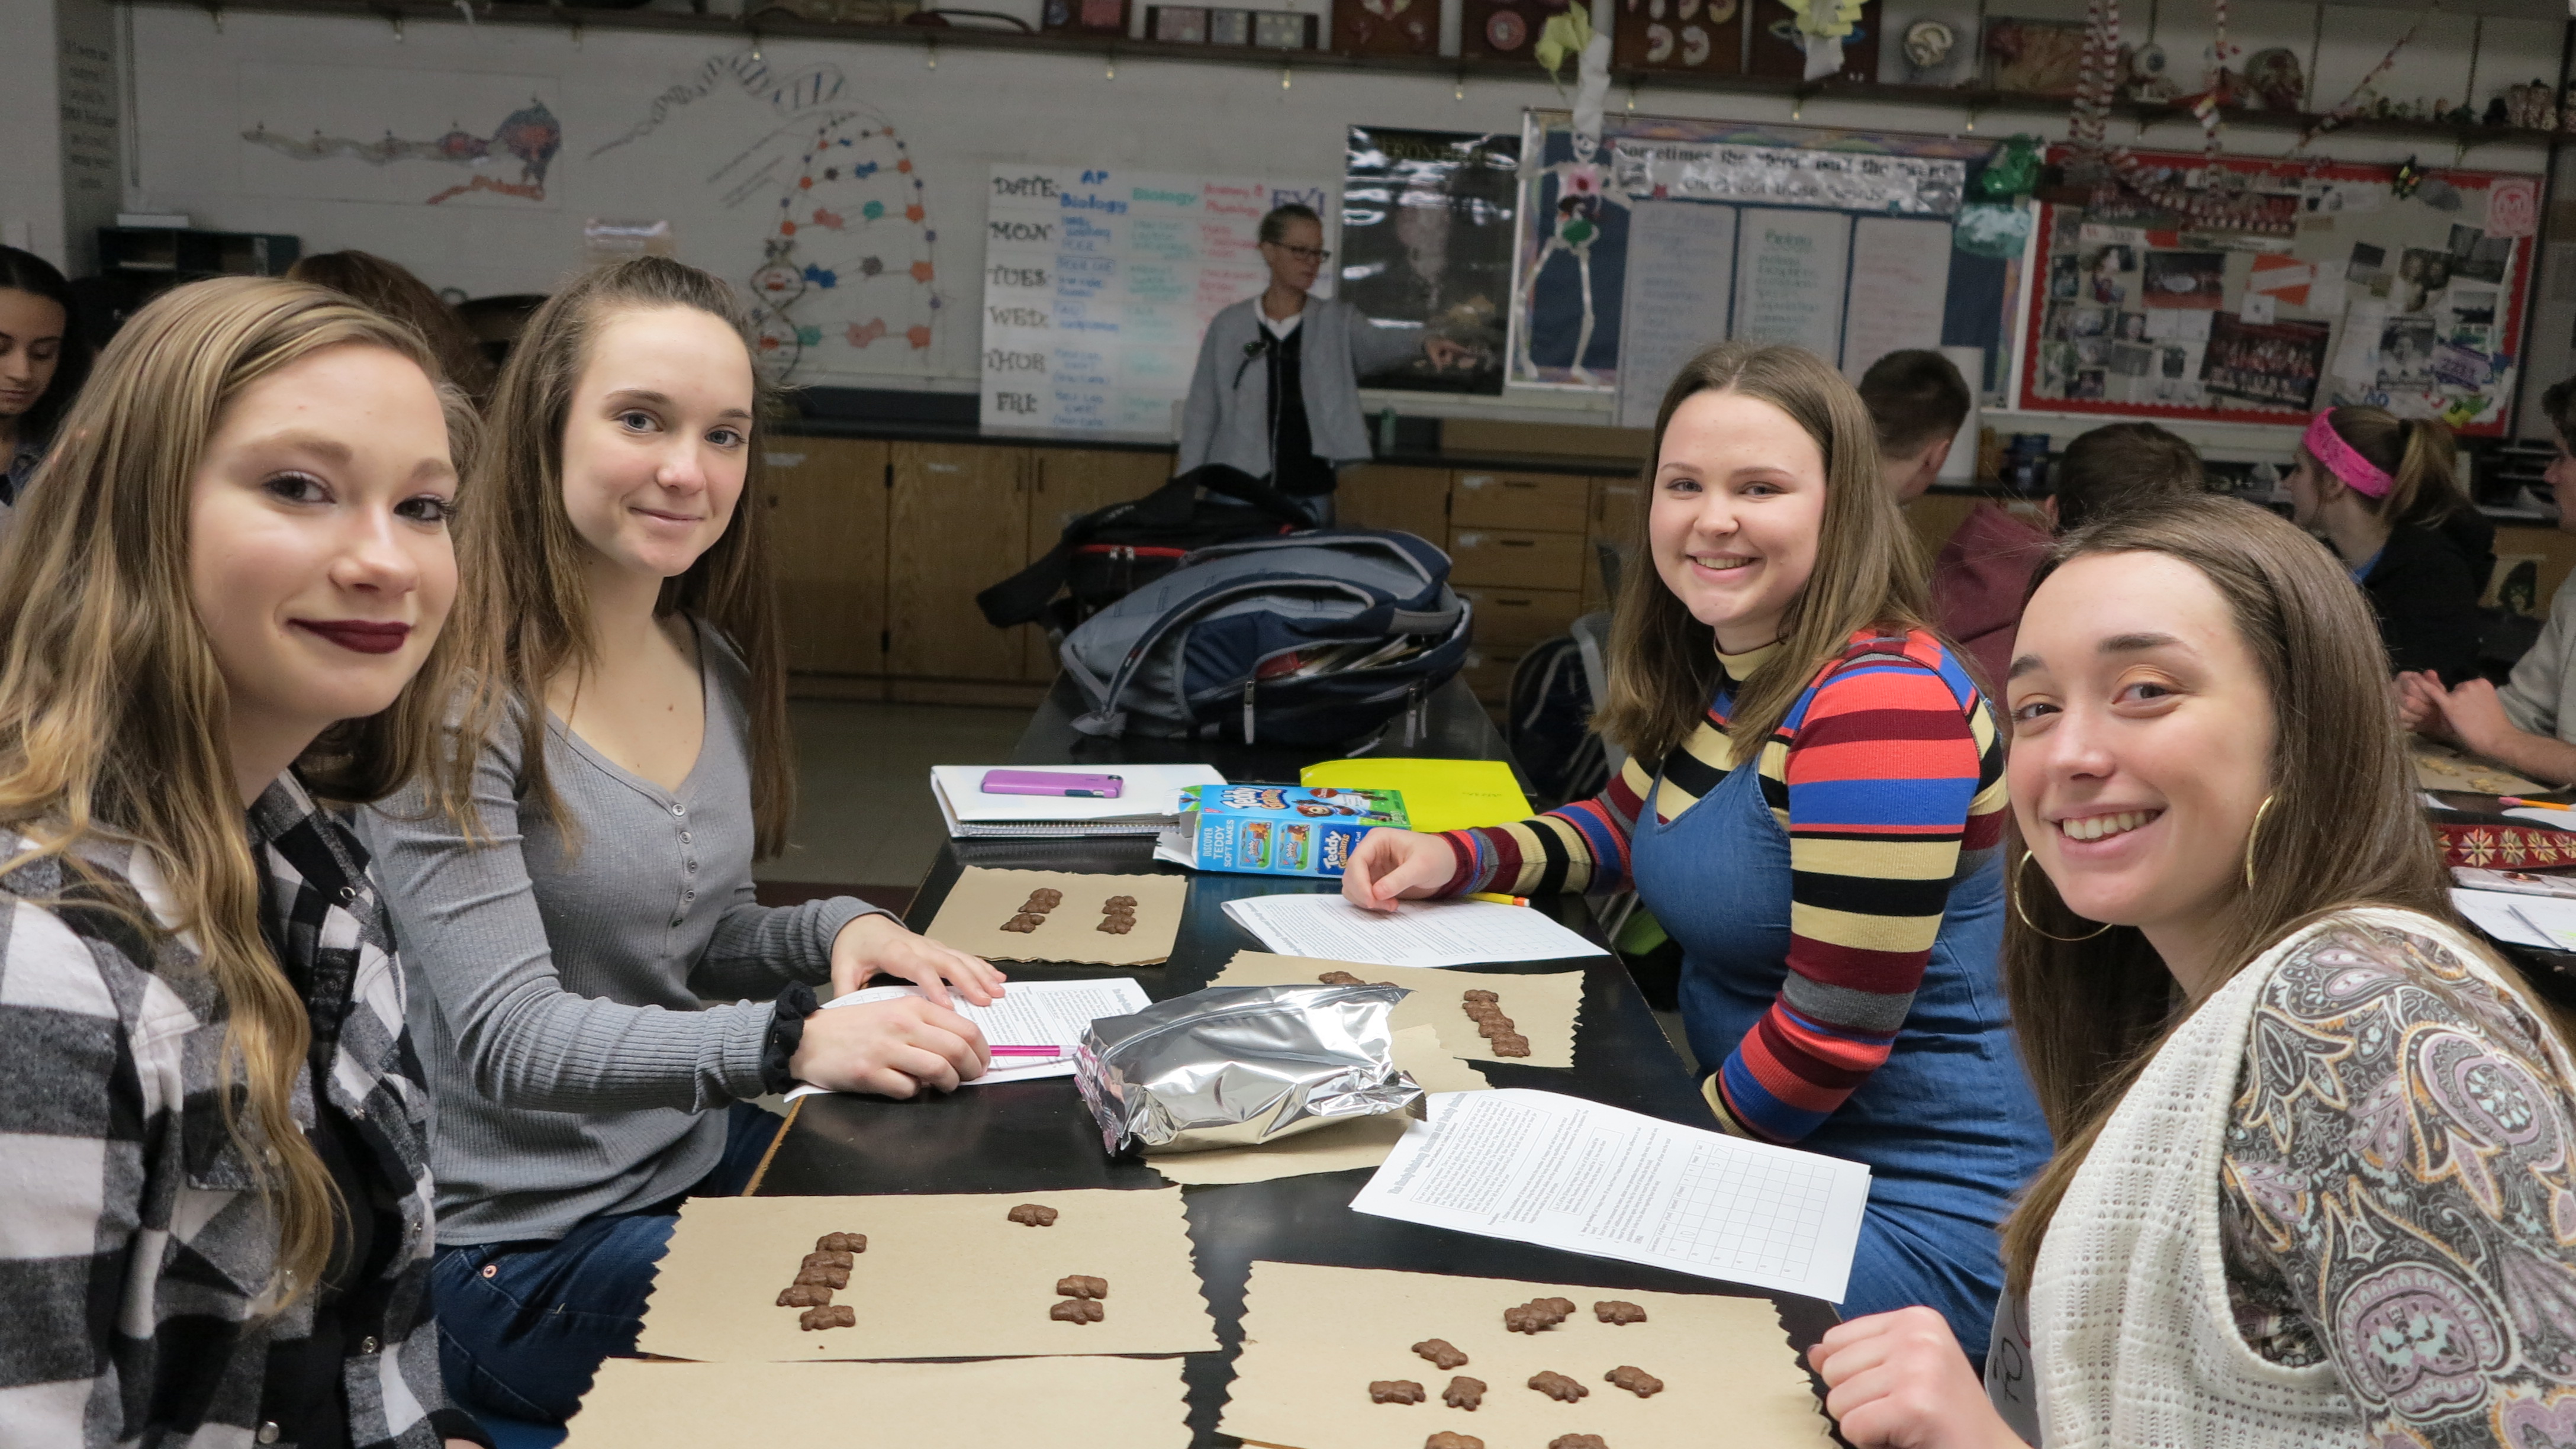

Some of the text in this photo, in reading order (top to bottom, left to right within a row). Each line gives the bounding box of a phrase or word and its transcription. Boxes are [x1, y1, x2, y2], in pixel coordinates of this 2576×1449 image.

[1081, 170, 1109, 185] AP
[1061, 192, 1127, 214] Biology
[1221, 787, 1264, 809] Teddy
[1203, 827, 1213, 856] DISCOVER
[1213, 826, 1225, 859] TEDDY
[1224, 819, 1235, 868] SOFT BAKES
[1323, 830, 1342, 869] Teddy
